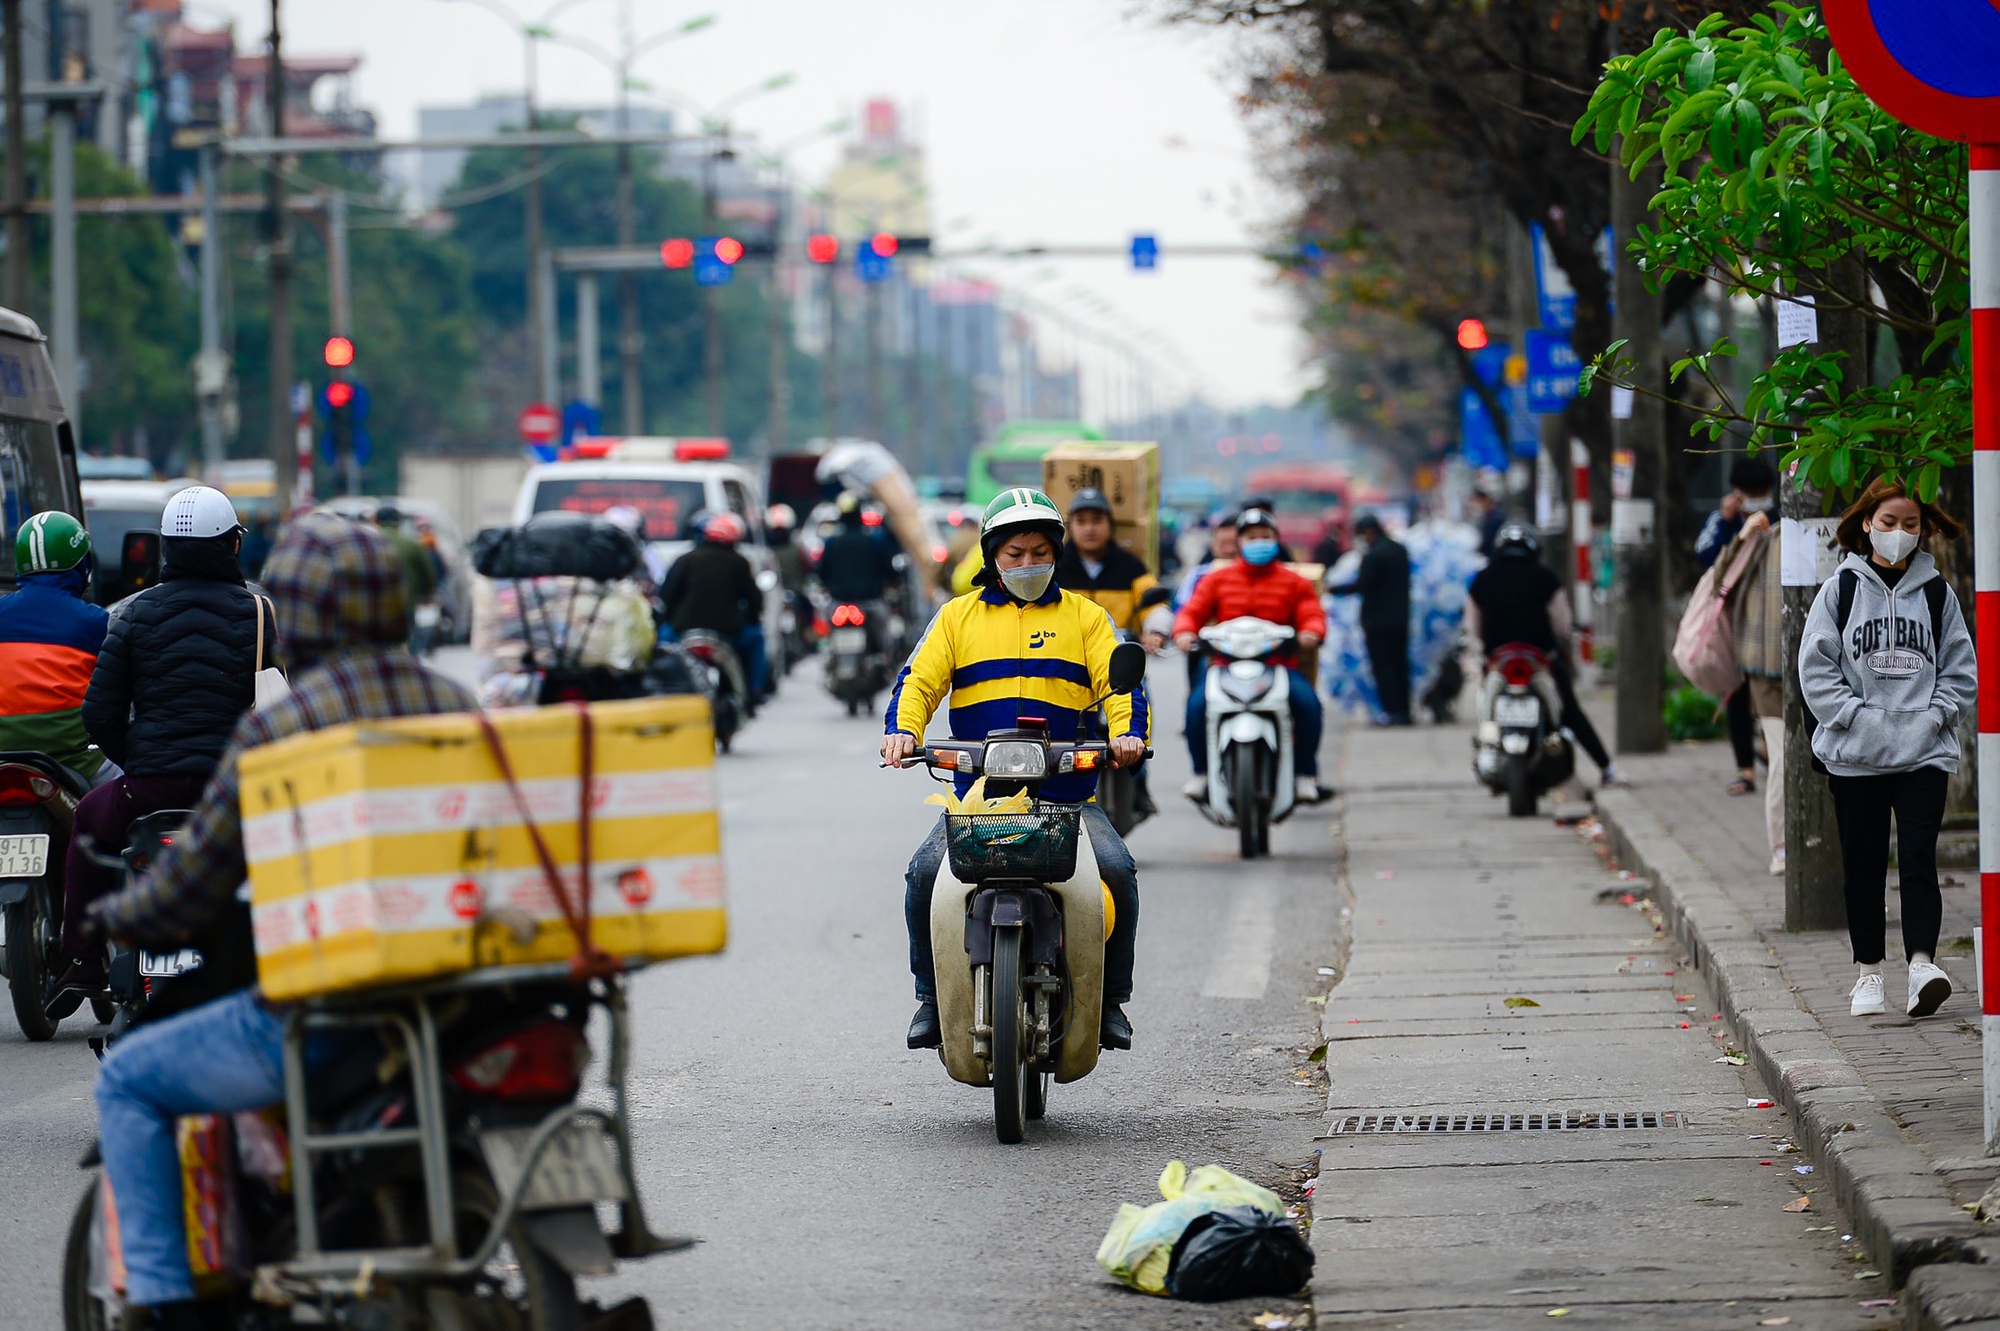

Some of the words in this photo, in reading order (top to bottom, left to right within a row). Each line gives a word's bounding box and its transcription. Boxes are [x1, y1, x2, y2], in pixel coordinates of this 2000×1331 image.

[1043, 630, 1056, 638] be
[1852, 616, 1934, 666] SOFTBALL
[1869, 654, 1921, 670] GRANDMA
